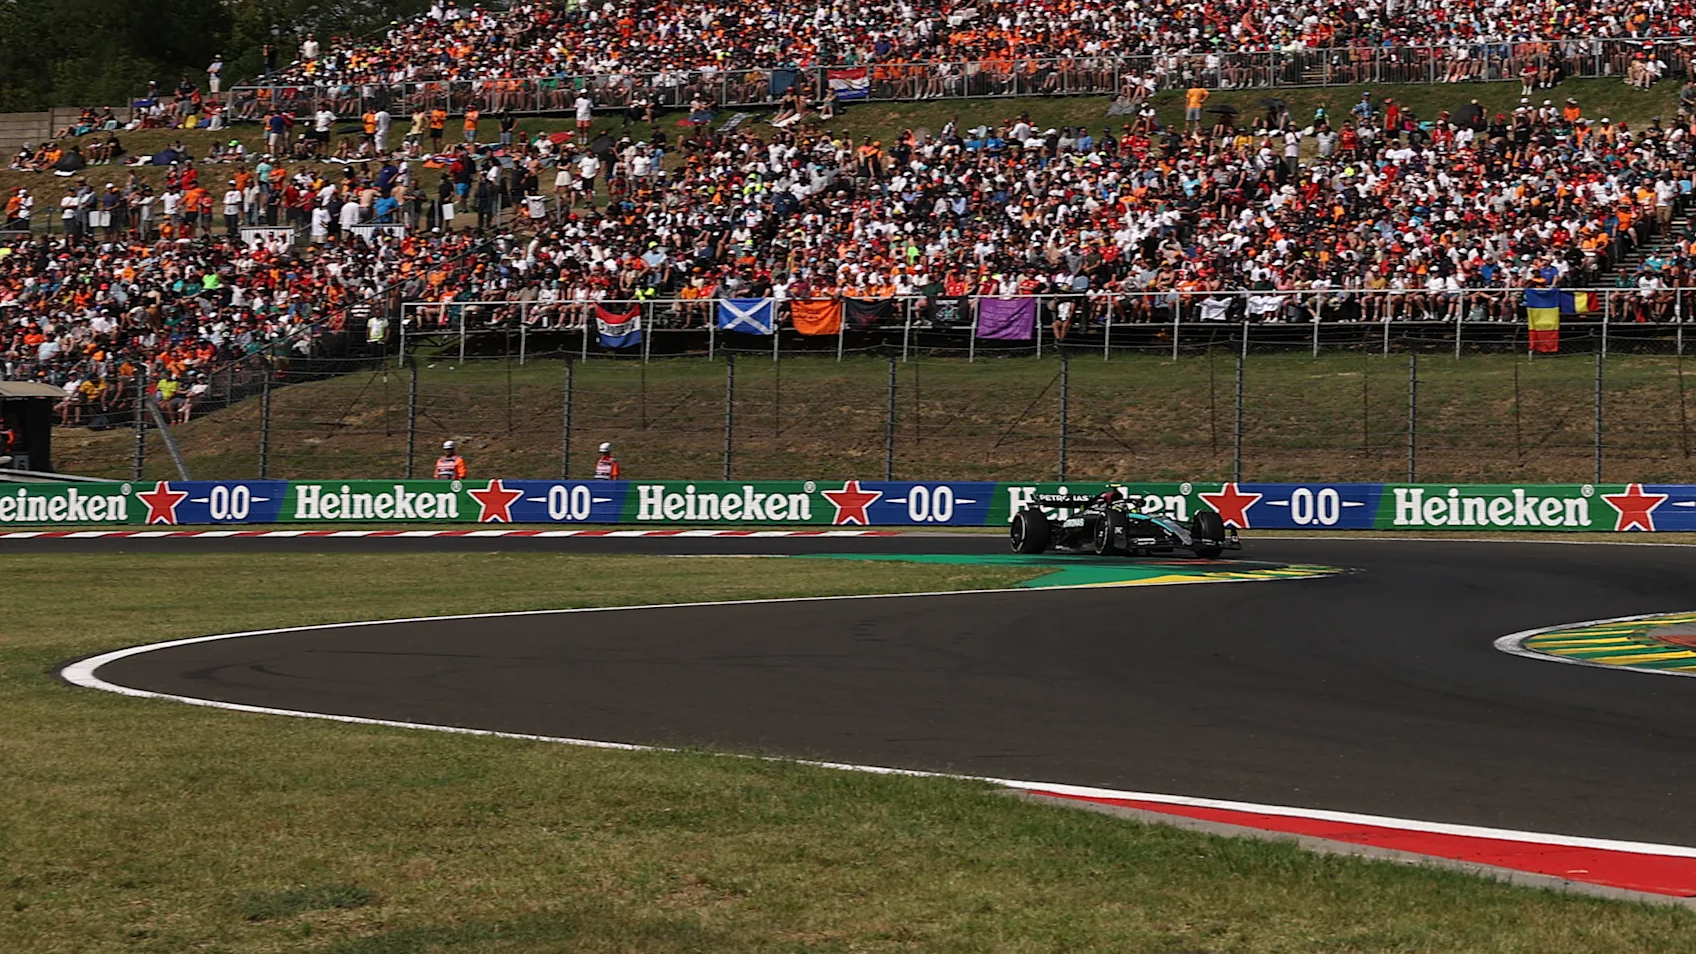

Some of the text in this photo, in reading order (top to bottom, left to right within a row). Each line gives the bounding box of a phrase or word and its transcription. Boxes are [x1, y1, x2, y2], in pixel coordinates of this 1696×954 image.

[210, 486, 249, 520] 0.0
[295, 485, 591, 520] Heineken 0.0
[637, 485, 953, 521] Heineken 0.0
[1291, 488, 1340, 525] 0.0
[1393, 488, 1592, 526] Heineken
